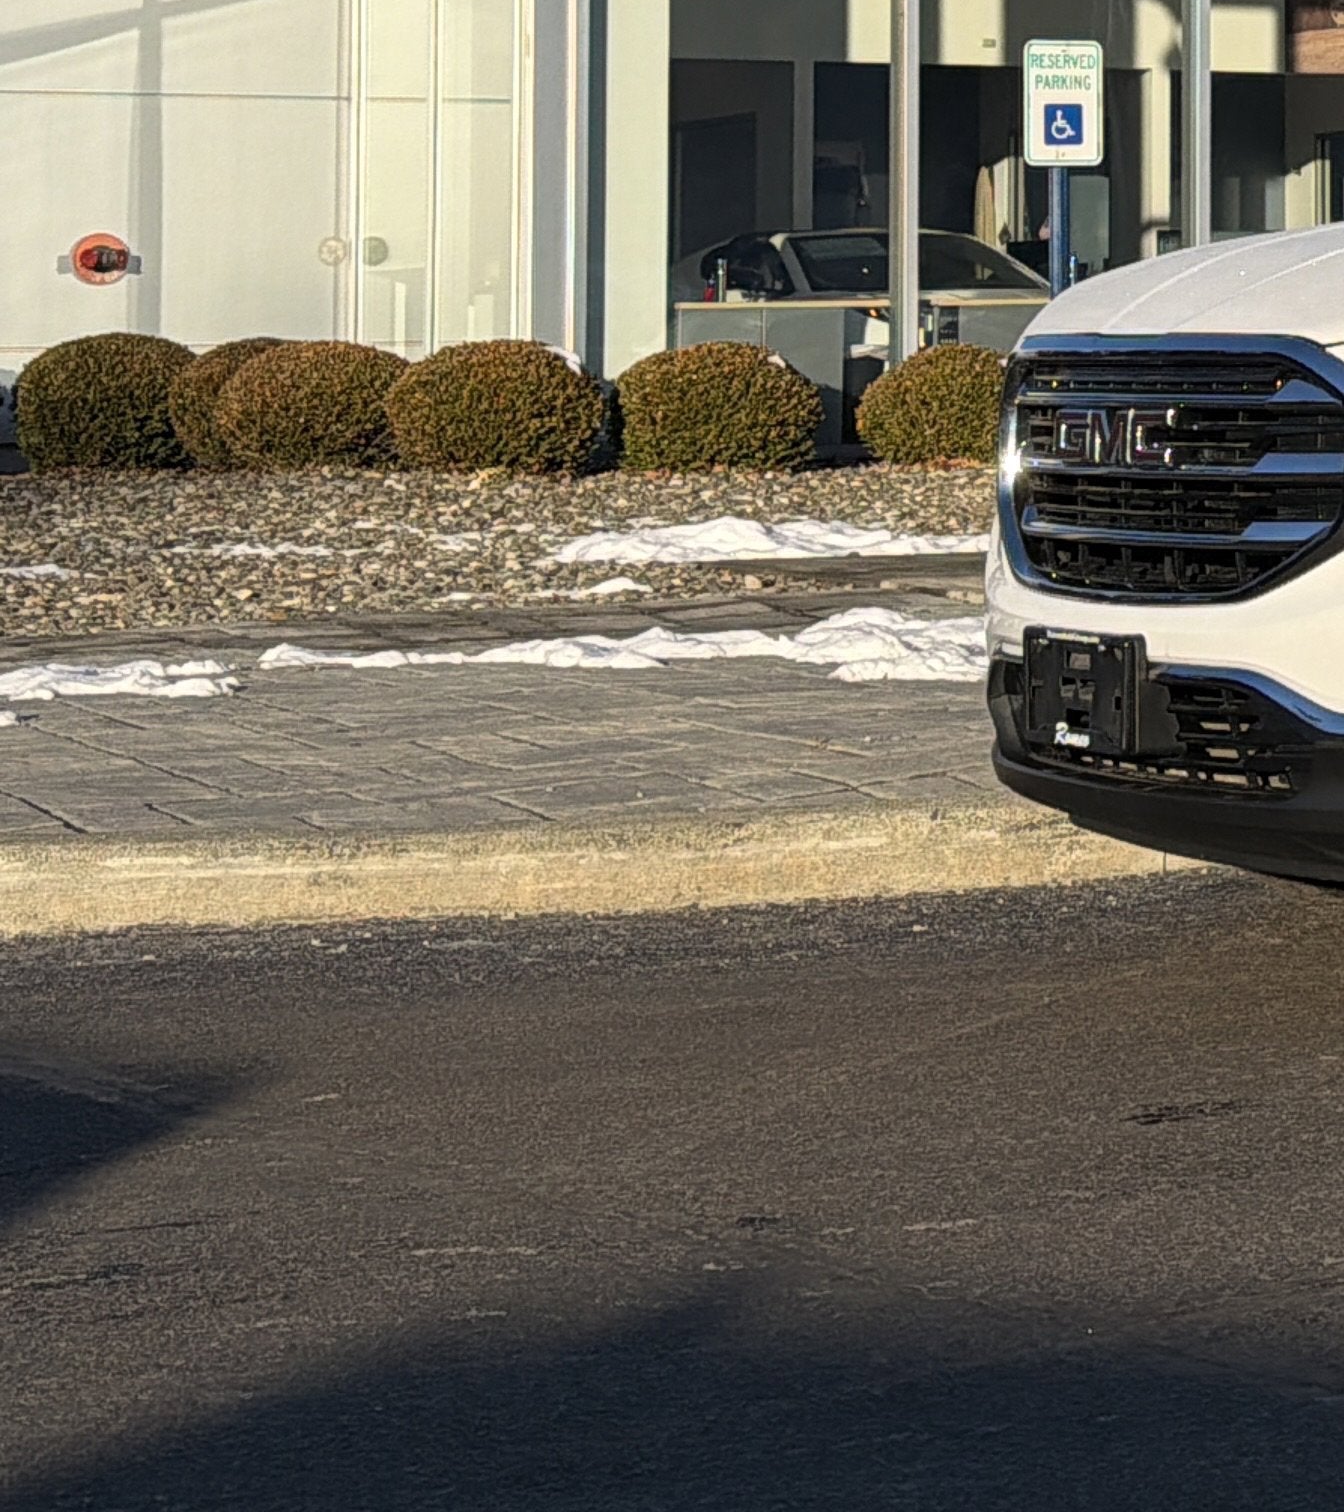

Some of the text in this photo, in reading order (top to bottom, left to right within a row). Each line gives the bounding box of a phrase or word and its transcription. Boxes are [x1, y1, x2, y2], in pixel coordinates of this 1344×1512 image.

[1028, 53, 1097, 70] RESERVED
[1034, 74, 1092, 91] PARKING
[1053, 408, 1177, 466] GMC
